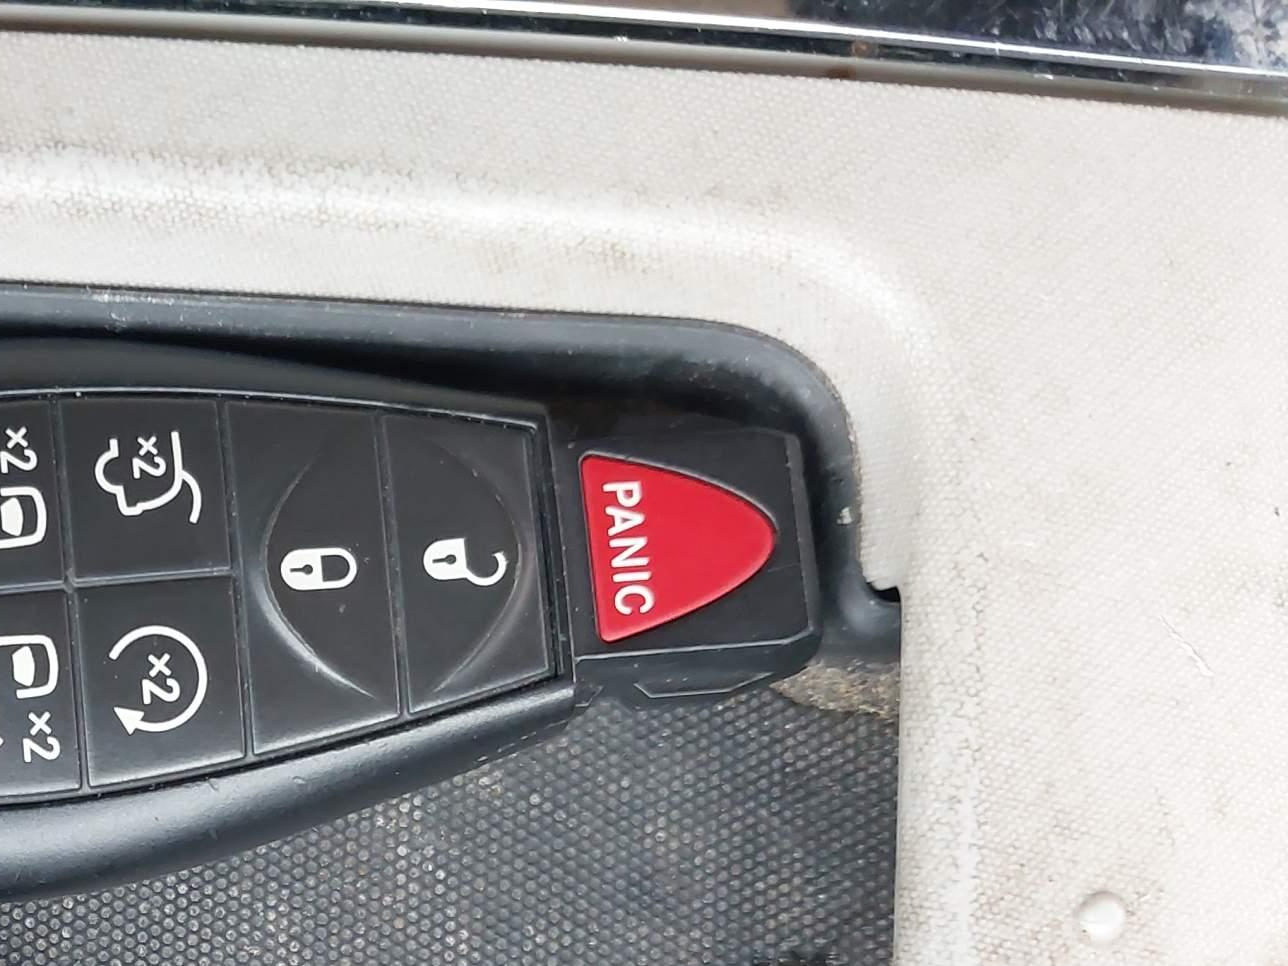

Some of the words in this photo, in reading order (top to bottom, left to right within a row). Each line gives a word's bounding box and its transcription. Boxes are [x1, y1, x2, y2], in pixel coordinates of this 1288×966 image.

[0, 426, 38, 474] x2
[132, 435, 167, 479] x2
[602, 480, 655, 616] PANIC
[141, 652, 181, 705] x2
[22, 711, 63, 763] x2
